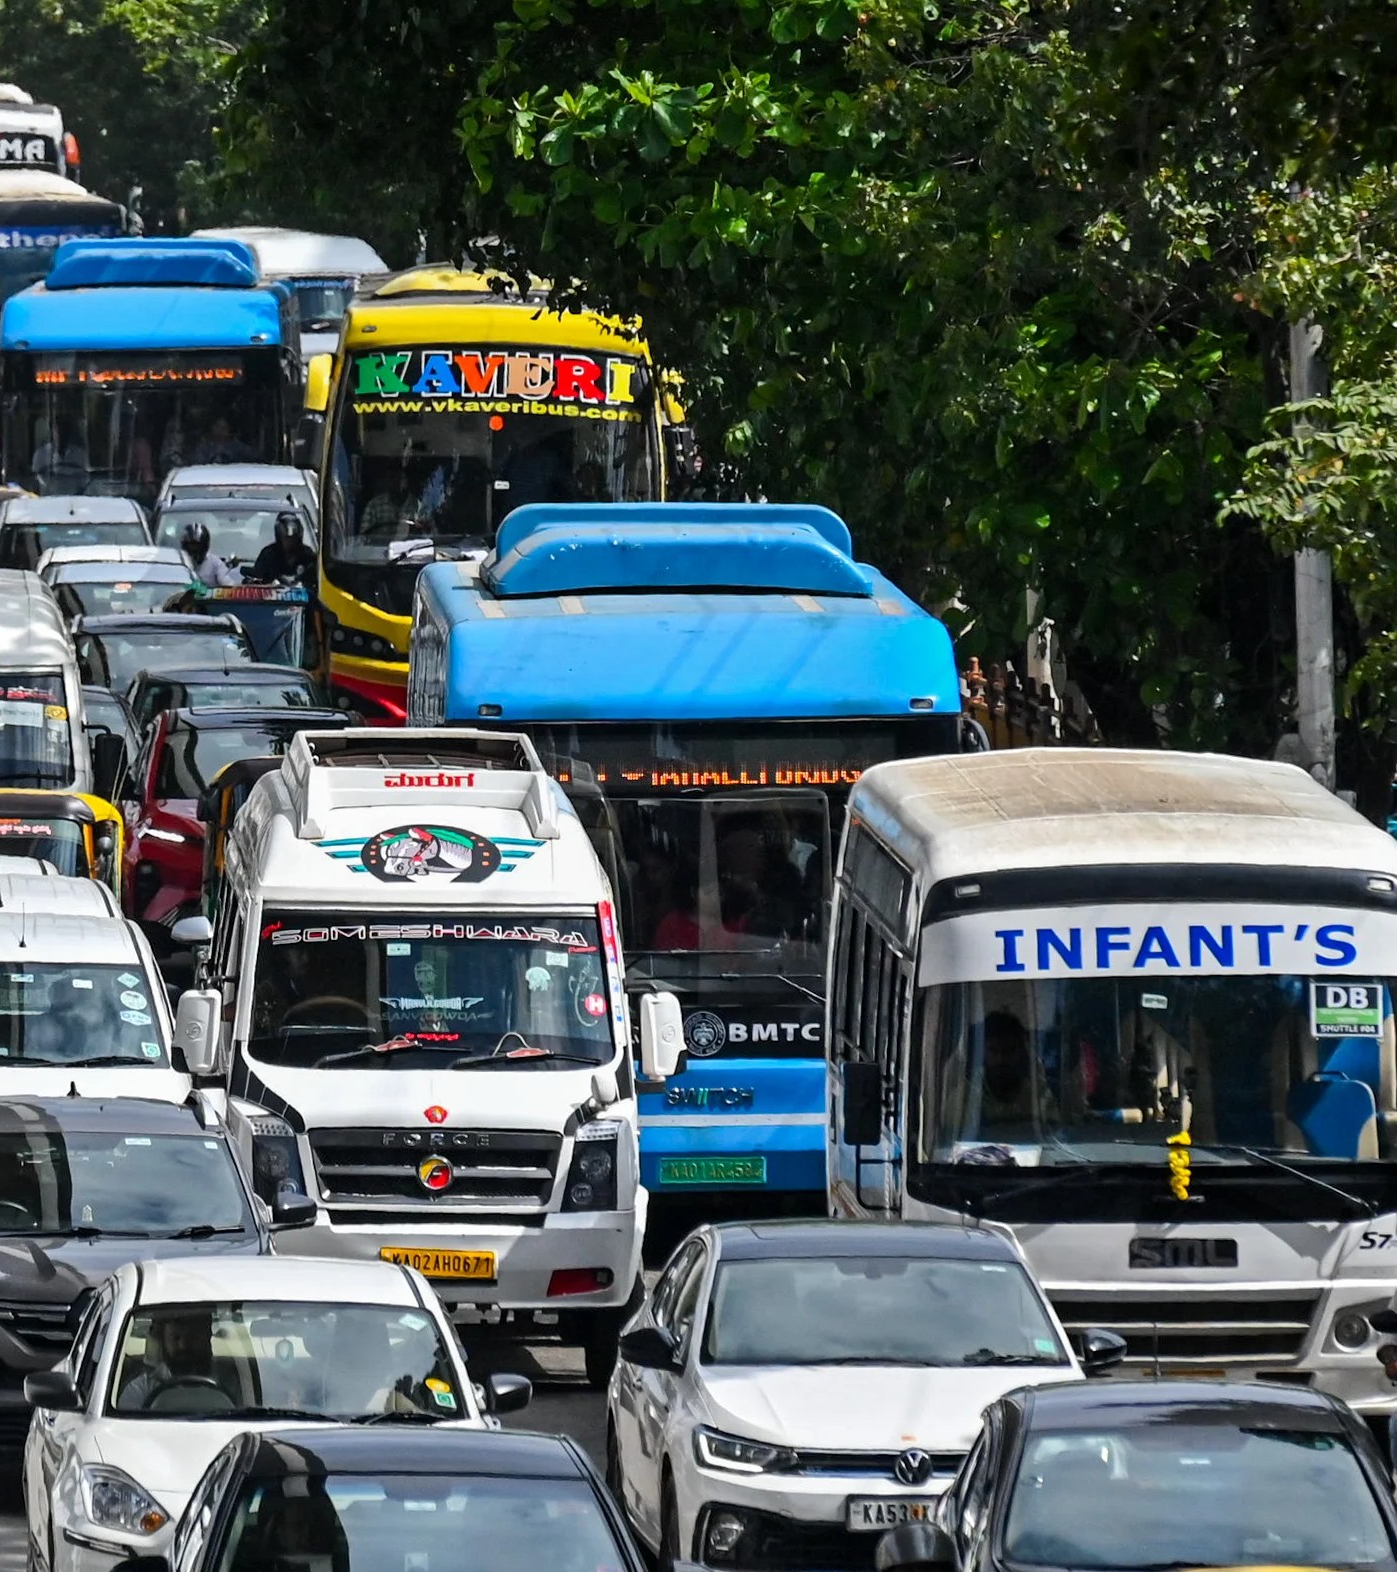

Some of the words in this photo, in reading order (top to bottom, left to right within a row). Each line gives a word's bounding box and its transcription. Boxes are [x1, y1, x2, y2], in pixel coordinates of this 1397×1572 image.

[354, 352, 635, 404] KAVERI
[353, 399, 642, 423] www.vkaveribus.com
[384, 773, 474, 787] ಮುರುಗ
[271, 924, 588, 947] SOMESHWARA
[995, 924, 1358, 972] INFANT'S
[1327, 986, 1369, 1009] DB
[728, 1023, 821, 1042] BMTC
[1320, 1025, 1358, 1033] SHUTTLE
[383, 1133, 489, 1146] FORCE
[392, 1253, 490, 1273] KA02AH0671
